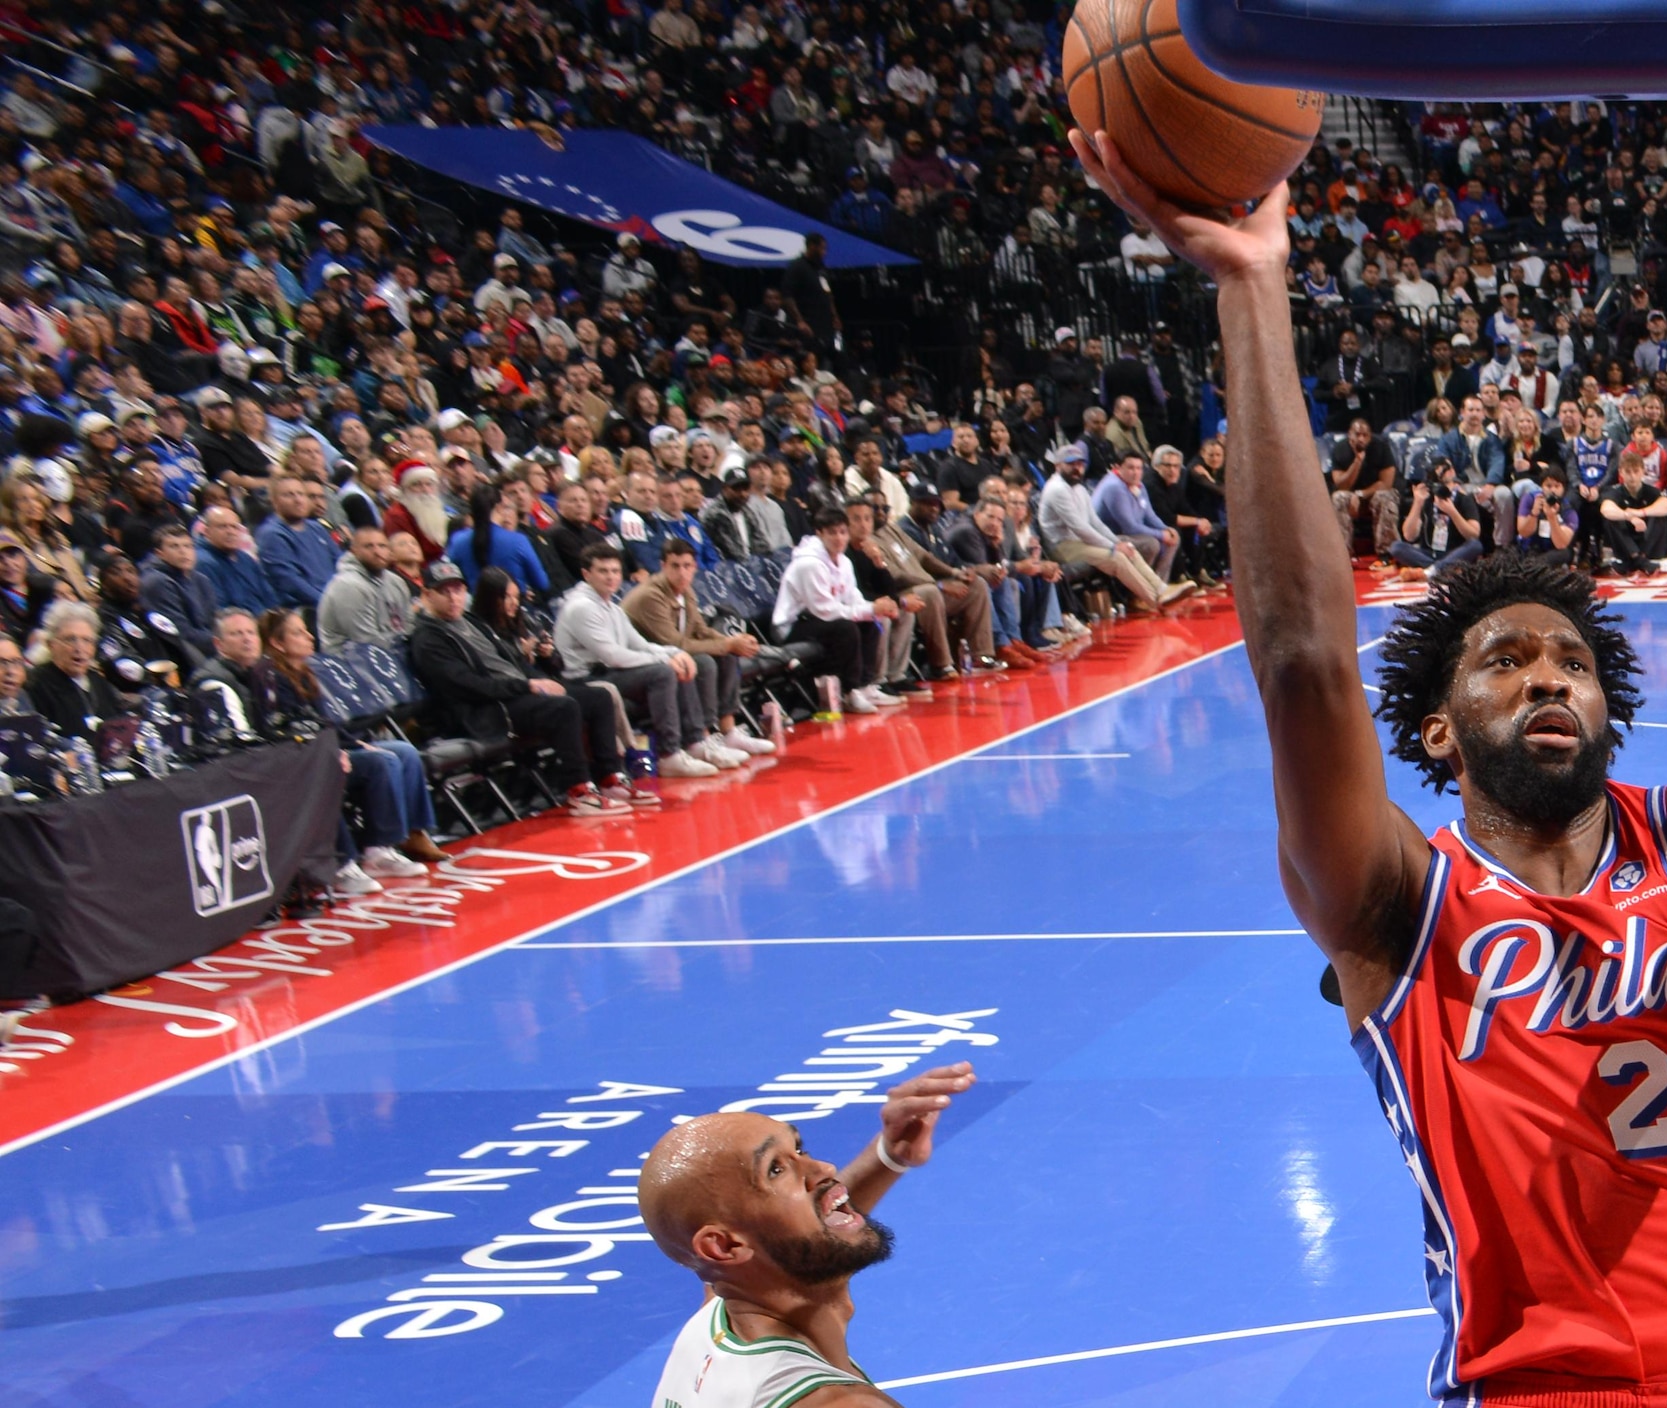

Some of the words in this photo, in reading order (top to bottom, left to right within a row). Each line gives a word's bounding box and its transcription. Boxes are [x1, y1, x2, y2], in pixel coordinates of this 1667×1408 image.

[670, 1007, 1000, 1125] xfinit
[316, 1080, 685, 1232] ARENA
[333, 1152, 656, 1340] obile
